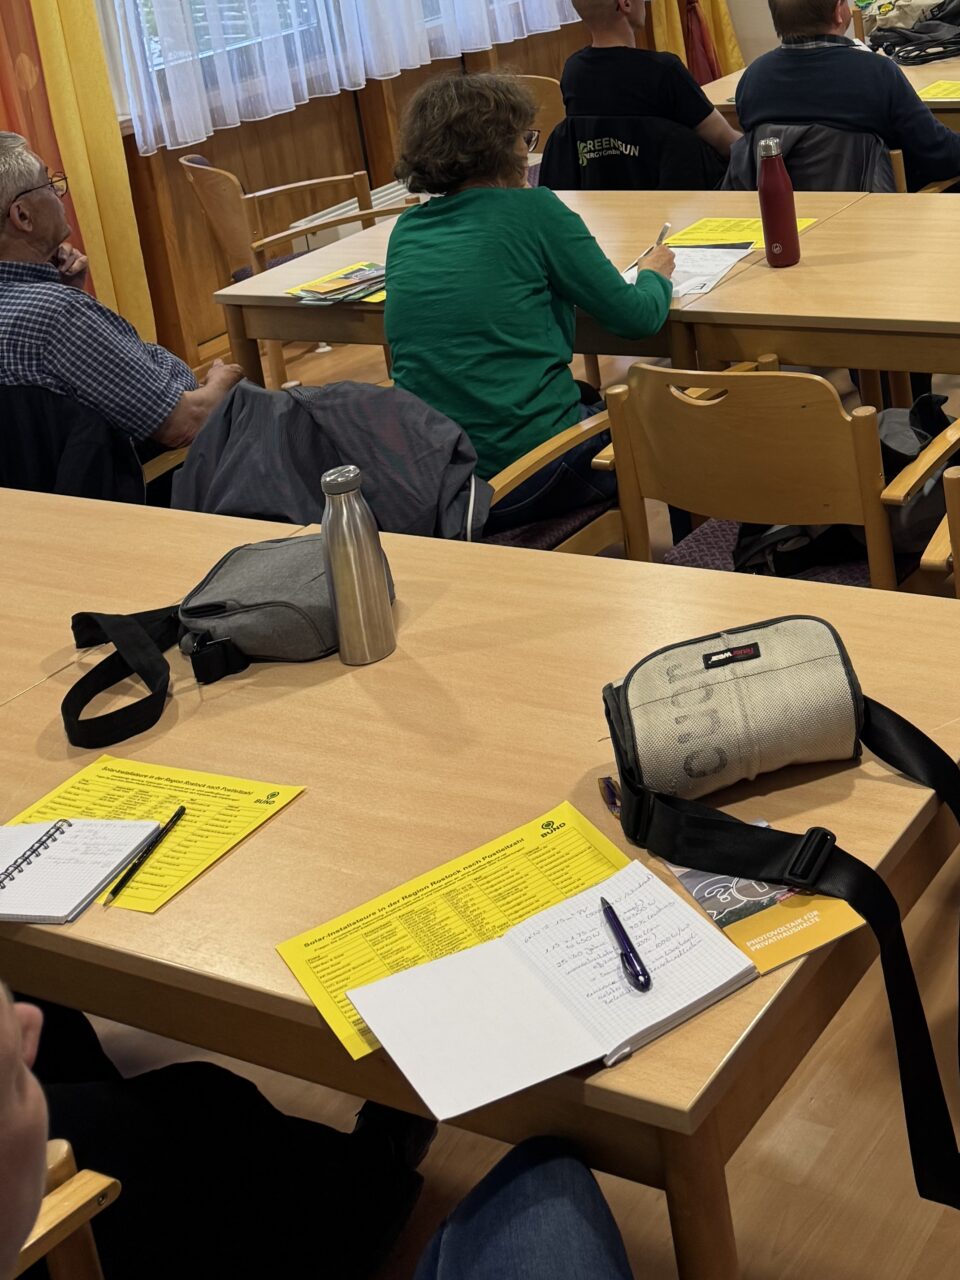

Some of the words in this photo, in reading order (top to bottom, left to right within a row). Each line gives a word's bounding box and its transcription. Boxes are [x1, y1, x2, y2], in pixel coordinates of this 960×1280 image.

[540, 822, 566, 838] BUND
[401, 885, 430, 901] Region
[430, 869, 461, 888] Rostock
[462, 859, 482, 871] nach
[745, 917, 803, 948] PHOTOVOLTAIK
[804, 909, 820, 923] FÜR
[750, 917, 821, 951] PRIVATHAUSHALTE
